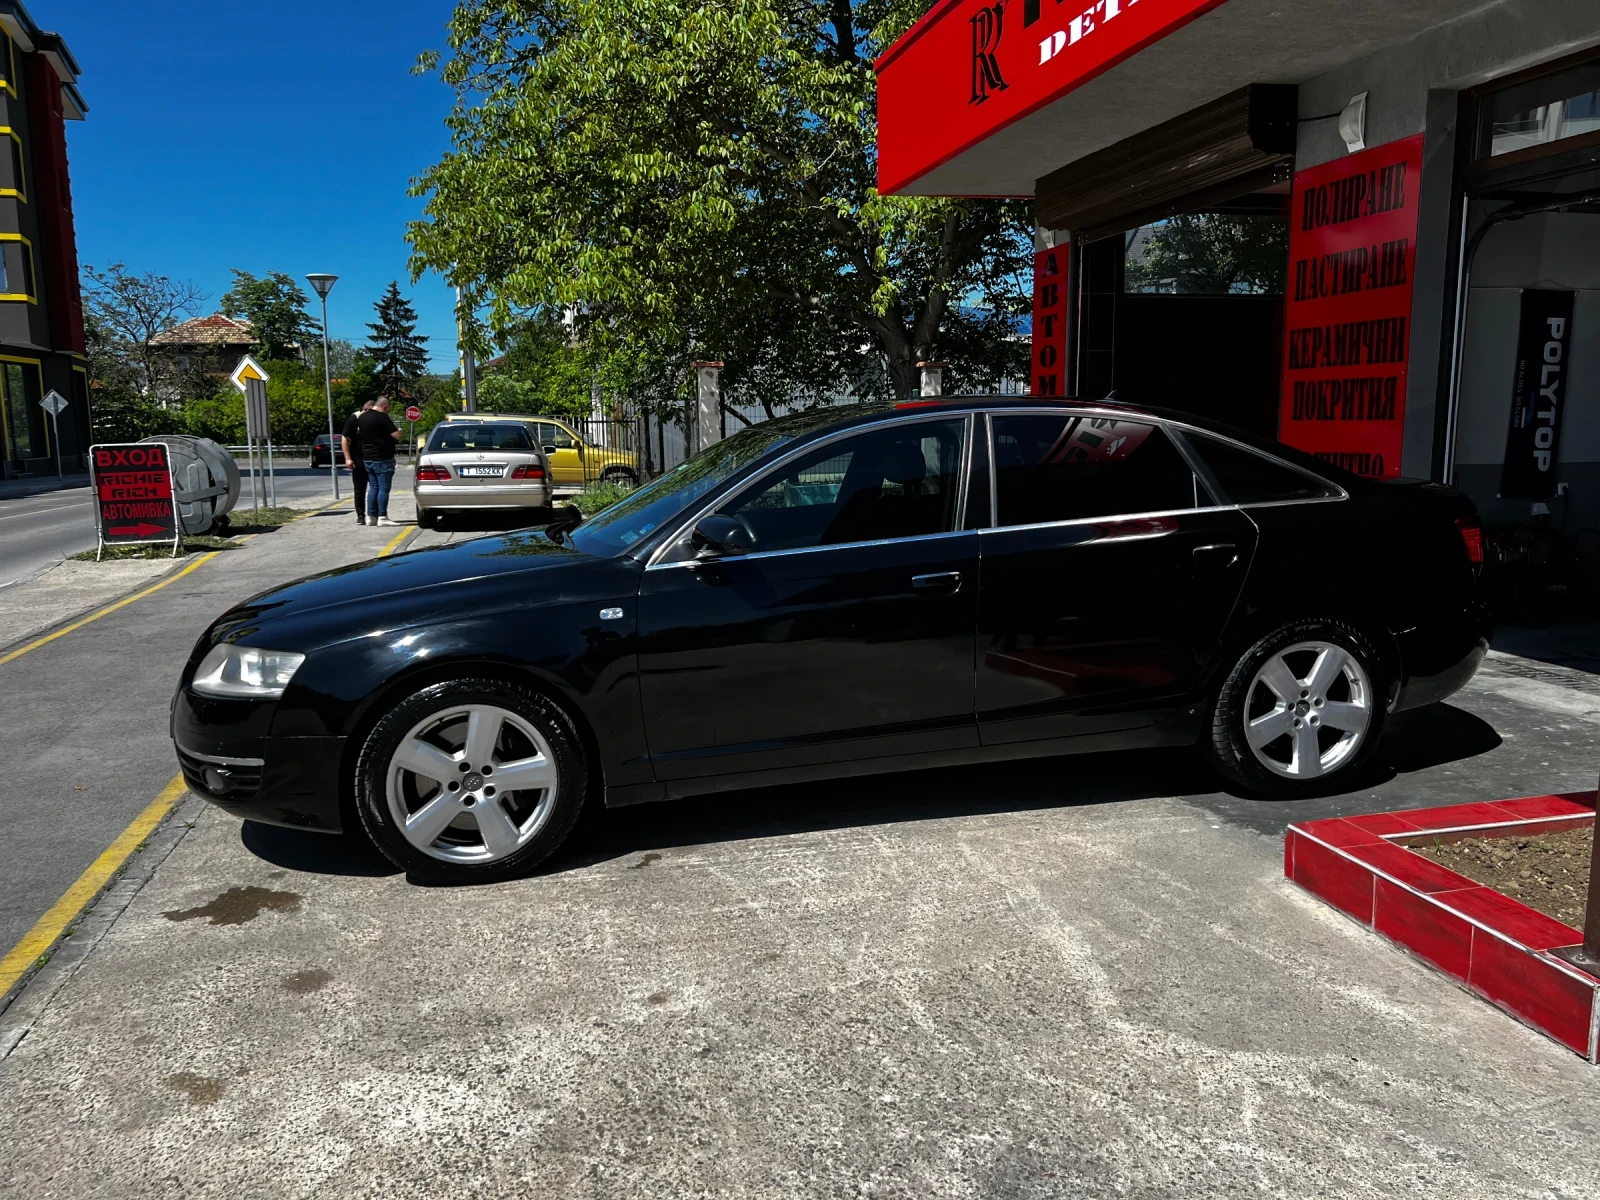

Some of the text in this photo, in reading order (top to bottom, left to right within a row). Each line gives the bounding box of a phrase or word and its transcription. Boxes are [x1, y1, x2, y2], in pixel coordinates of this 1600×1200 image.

[1302, 161, 1407, 232] ПОЛИРАНЕ
[1294, 238, 1408, 302] ПАСТИРАНЕ
[1288, 316, 1406, 370] КЕРАМИЧНИ
[1292, 376, 1397, 421] ПОКРИТИЯ
[1533, 317, 1566, 472] POLYTOP
[96, 448, 165, 468] ВХОД
[101, 473, 164, 485] RICHIE
[103, 502, 171, 520] АВТОМИВКА
[112, 487, 157, 498] RICH
